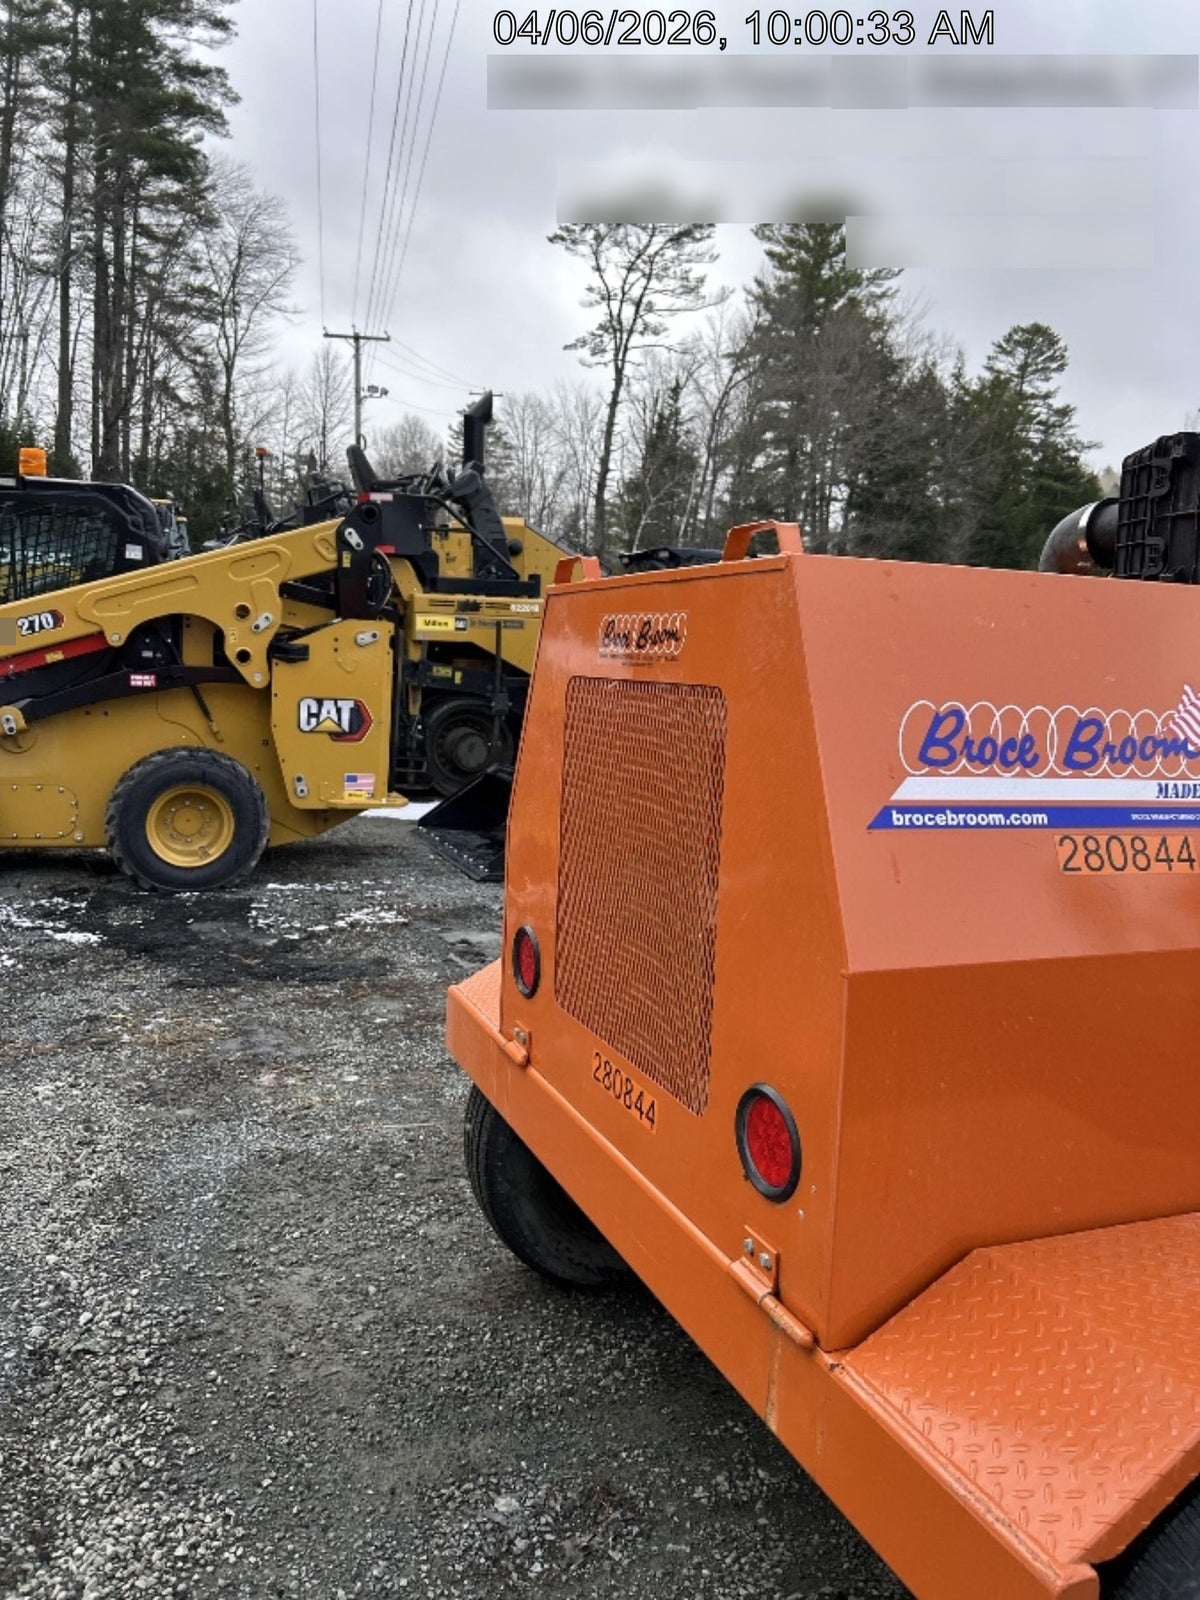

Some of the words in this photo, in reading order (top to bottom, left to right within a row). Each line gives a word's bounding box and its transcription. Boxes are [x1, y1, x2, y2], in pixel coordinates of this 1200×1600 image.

[16, 612, 54, 636] 270
[299, 699, 354, 733] CAT
[917, 708, 1040, 768] Broce
[1062, 717, 1200, 771] Broom
[1155, 782, 1200, 799] MADE
[891, 809, 1048, 826] brocebroom.com
[1058, 834, 1196, 872] 280844
[593, 1051, 656, 1131] 280844
